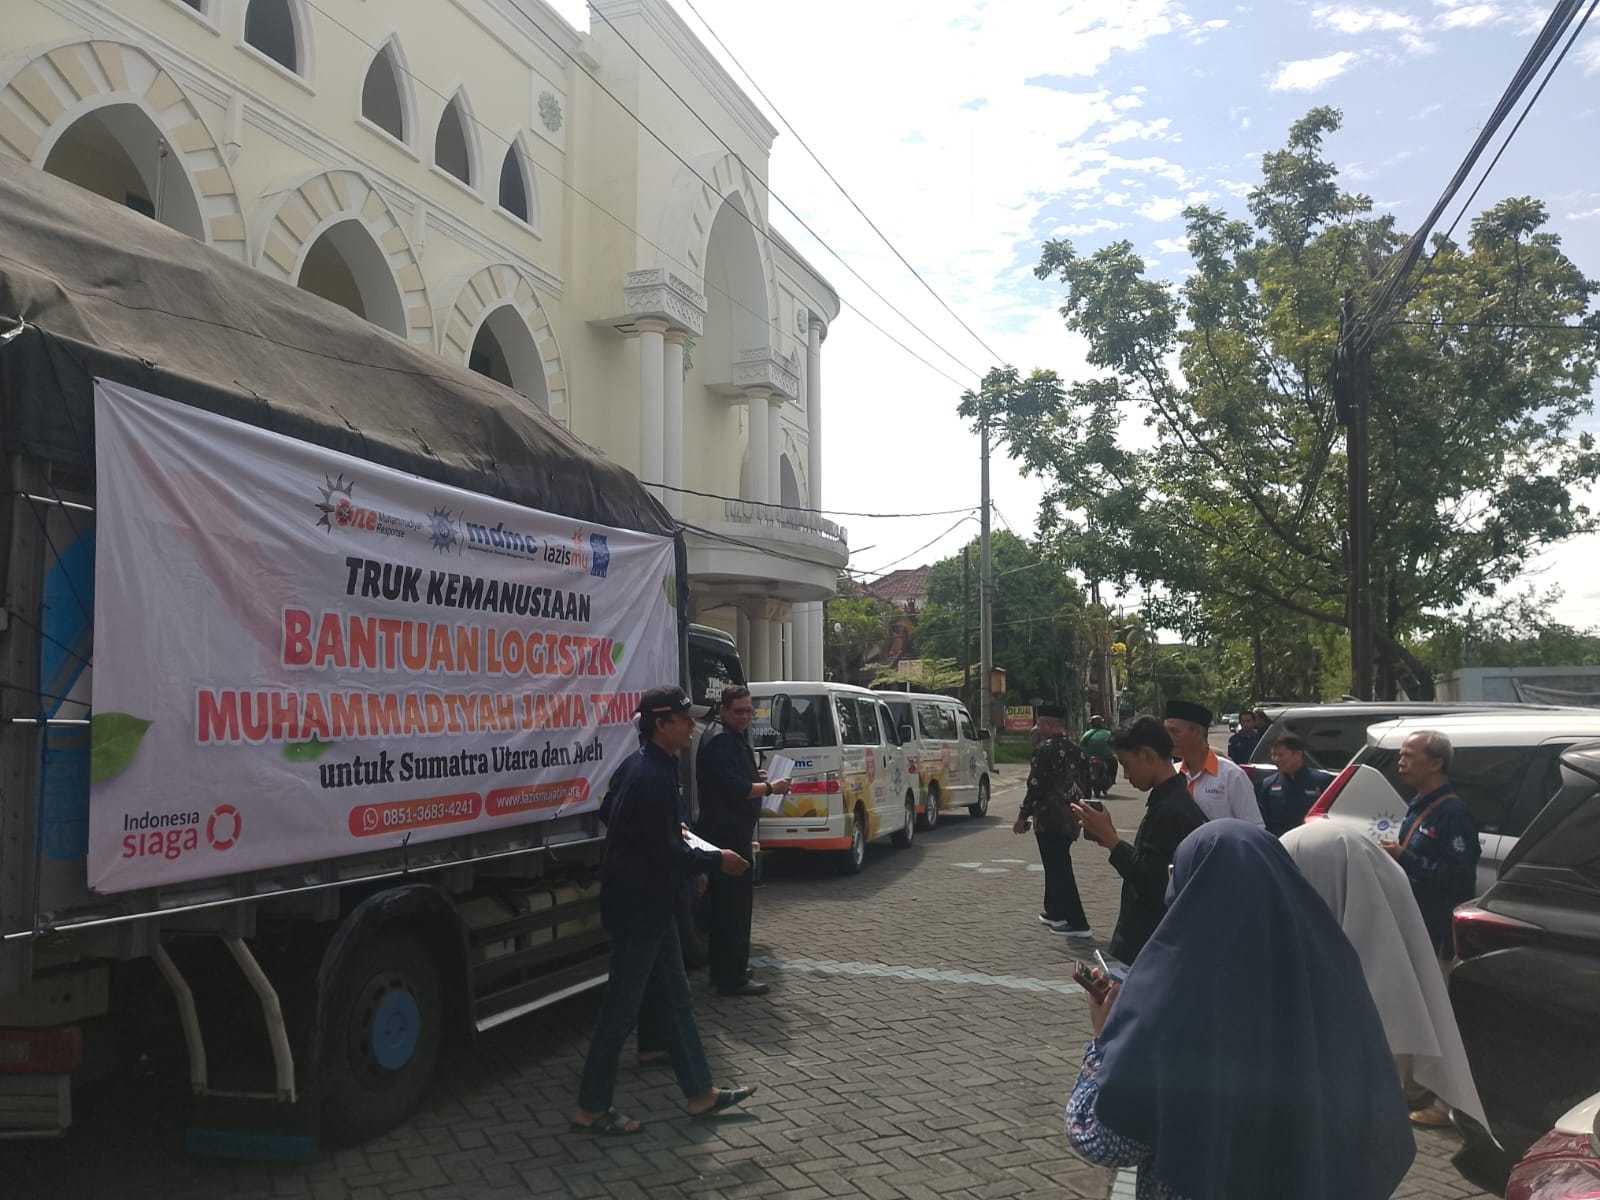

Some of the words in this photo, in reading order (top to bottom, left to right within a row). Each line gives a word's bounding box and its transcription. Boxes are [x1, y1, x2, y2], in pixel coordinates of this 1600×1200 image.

[466, 522, 538, 554] mdmc
[543, 540, 588, 569] lazismu
[345, 556, 423, 603] TRUK
[426, 570, 591, 622] KEMANUSIAAN
[283, 609, 479, 673] BANTUAN
[487, 628, 617, 676] LOGISTIK
[197, 690, 516, 741] MUHAMMADIYAH
[521, 692, 588, 730] JAWA
[590, 692, 645, 726] TIMU
[319, 750, 395, 788] untuk
[400, 748, 489, 782] Sumatra
[491, 746, 538, 773] Utara
[541, 741, 571, 768] dan
[573, 736, 603, 764] Aceh
[123, 810, 200, 831] Indonesia
[382, 799, 474, 826] 0851-3683-4241
[122, 827, 198, 860] siaga
